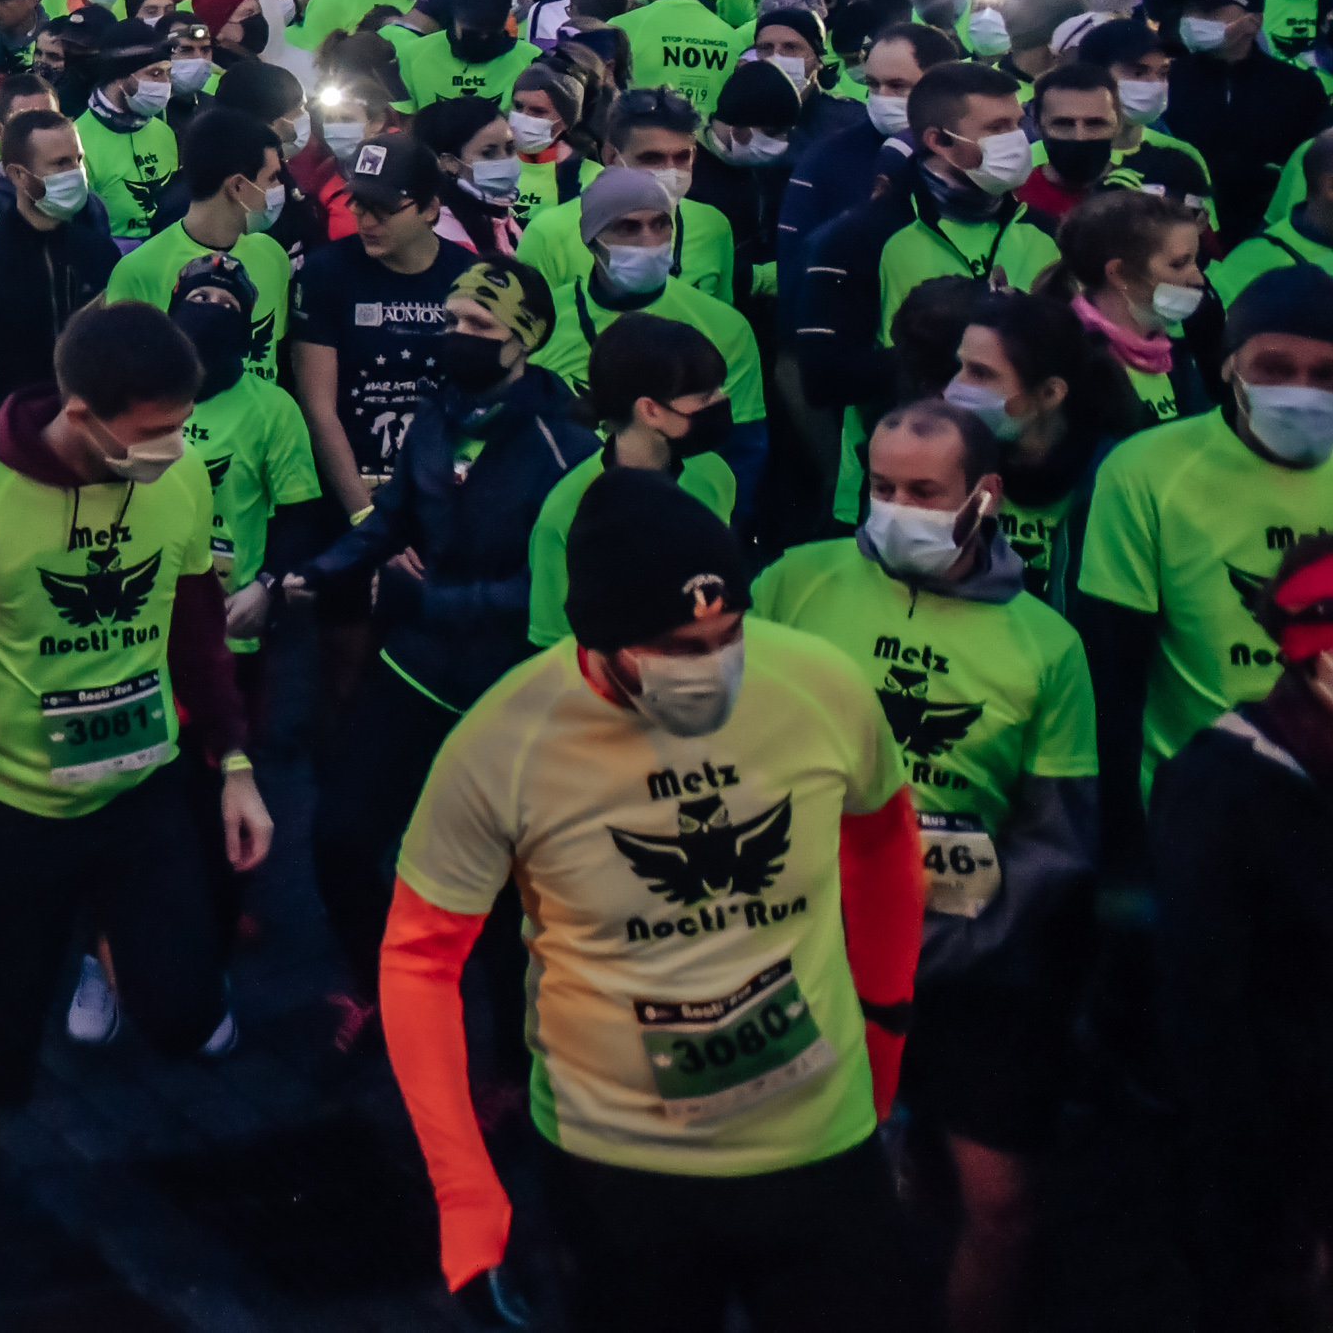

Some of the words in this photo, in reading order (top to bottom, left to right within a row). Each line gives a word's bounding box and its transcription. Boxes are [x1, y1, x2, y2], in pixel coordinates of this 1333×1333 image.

[661, 36, 683, 44] STOP
[662, 46, 729, 71] NOW
[452, 75, 486, 87] Metz
[134, 152, 159, 167] Metz
[383, 307, 445, 323] AUMON
[183, 423, 210, 441] etz
[74, 524, 133, 549] Metz
[38, 626, 161, 657] Nocti'Run
[874, 634, 950, 675] Metz
[65, 704, 150, 748] 3081
[646, 761, 741, 802] Metz
[925, 844, 976, 875] 46
[627, 895, 808, 942] Nocti'Run
[672, 1000, 792, 1074] 3080
